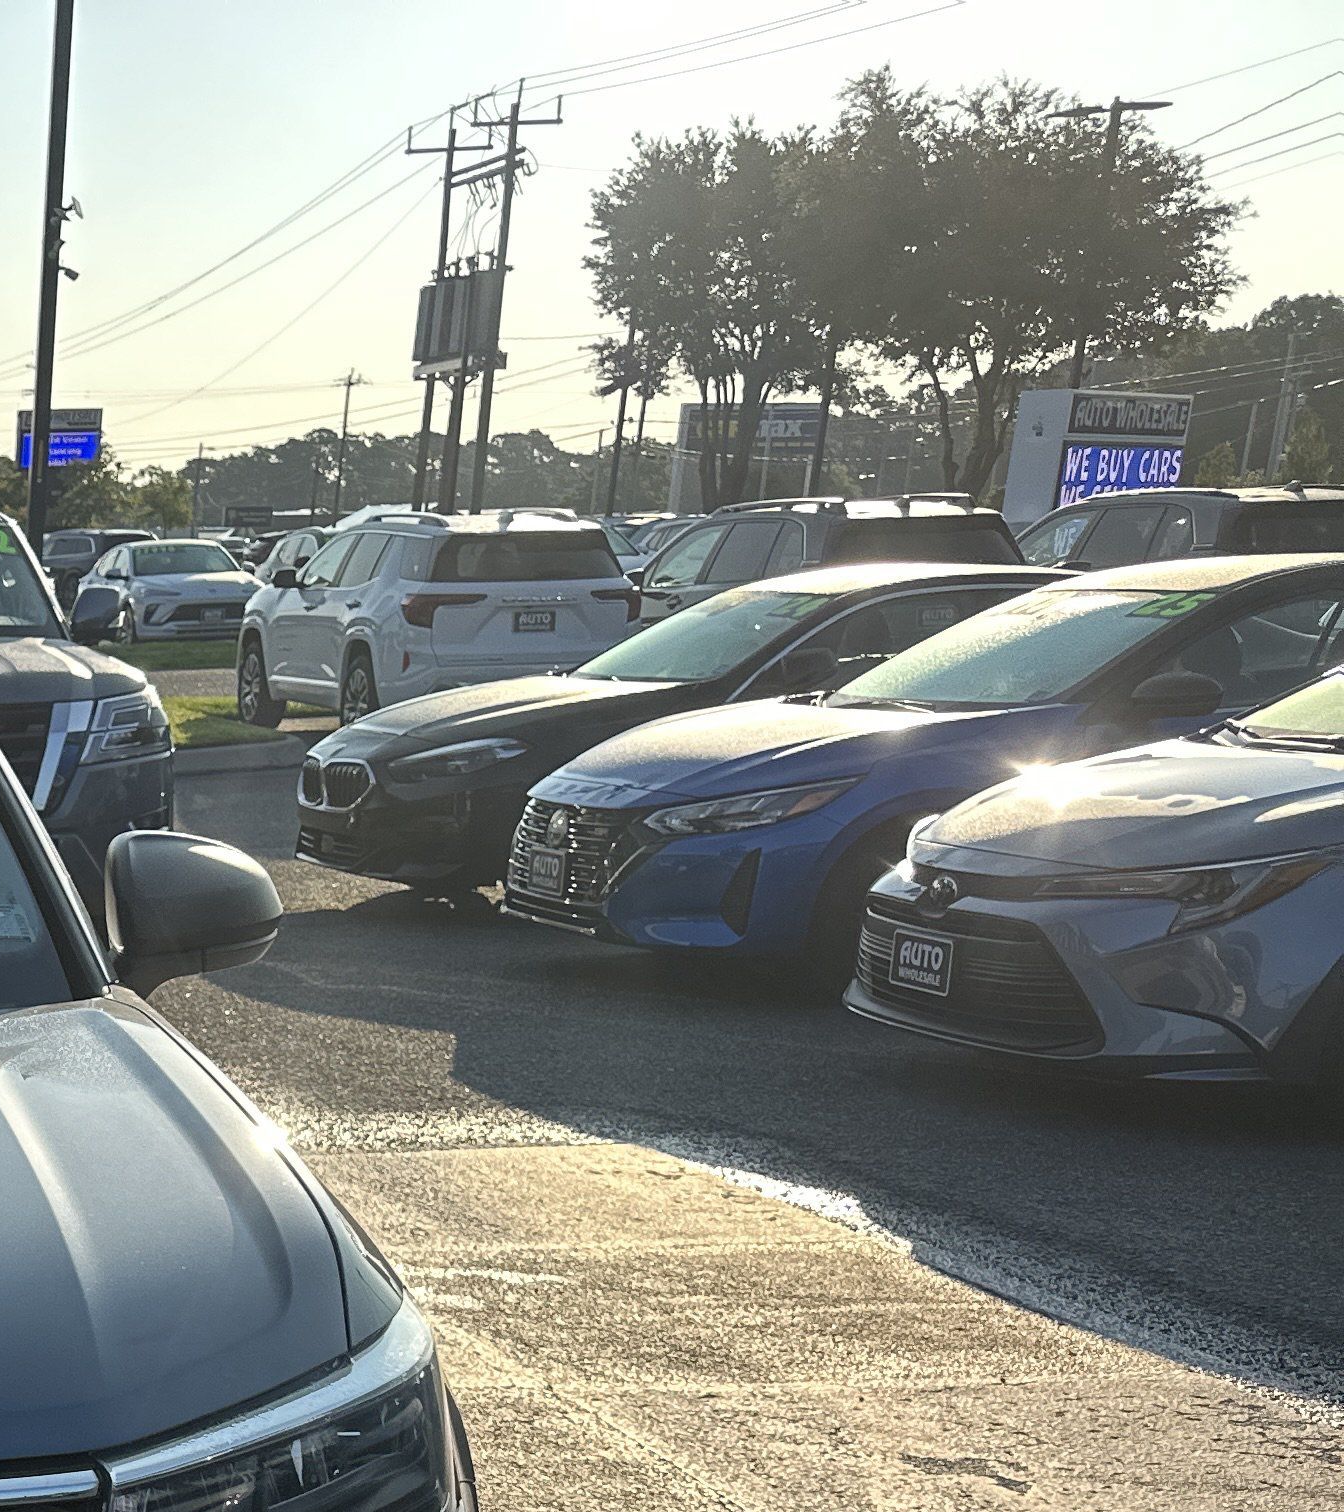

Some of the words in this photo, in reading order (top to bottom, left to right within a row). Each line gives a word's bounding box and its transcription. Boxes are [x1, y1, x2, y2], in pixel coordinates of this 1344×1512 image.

[1074, 401, 1112, 428] AUTO
[1115, 401, 1188, 432] WHOLESALE
[1064, 447, 1092, 483] WE
[1096, 448, 1134, 483] BUY
[1138, 449, 1182, 483] CARS
[1131, 591, 1217, 617] 25
[519, 613, 552, 625] AUTO
[533, 855, 560, 878] AUTO
[899, 940, 944, 971] AUTO
